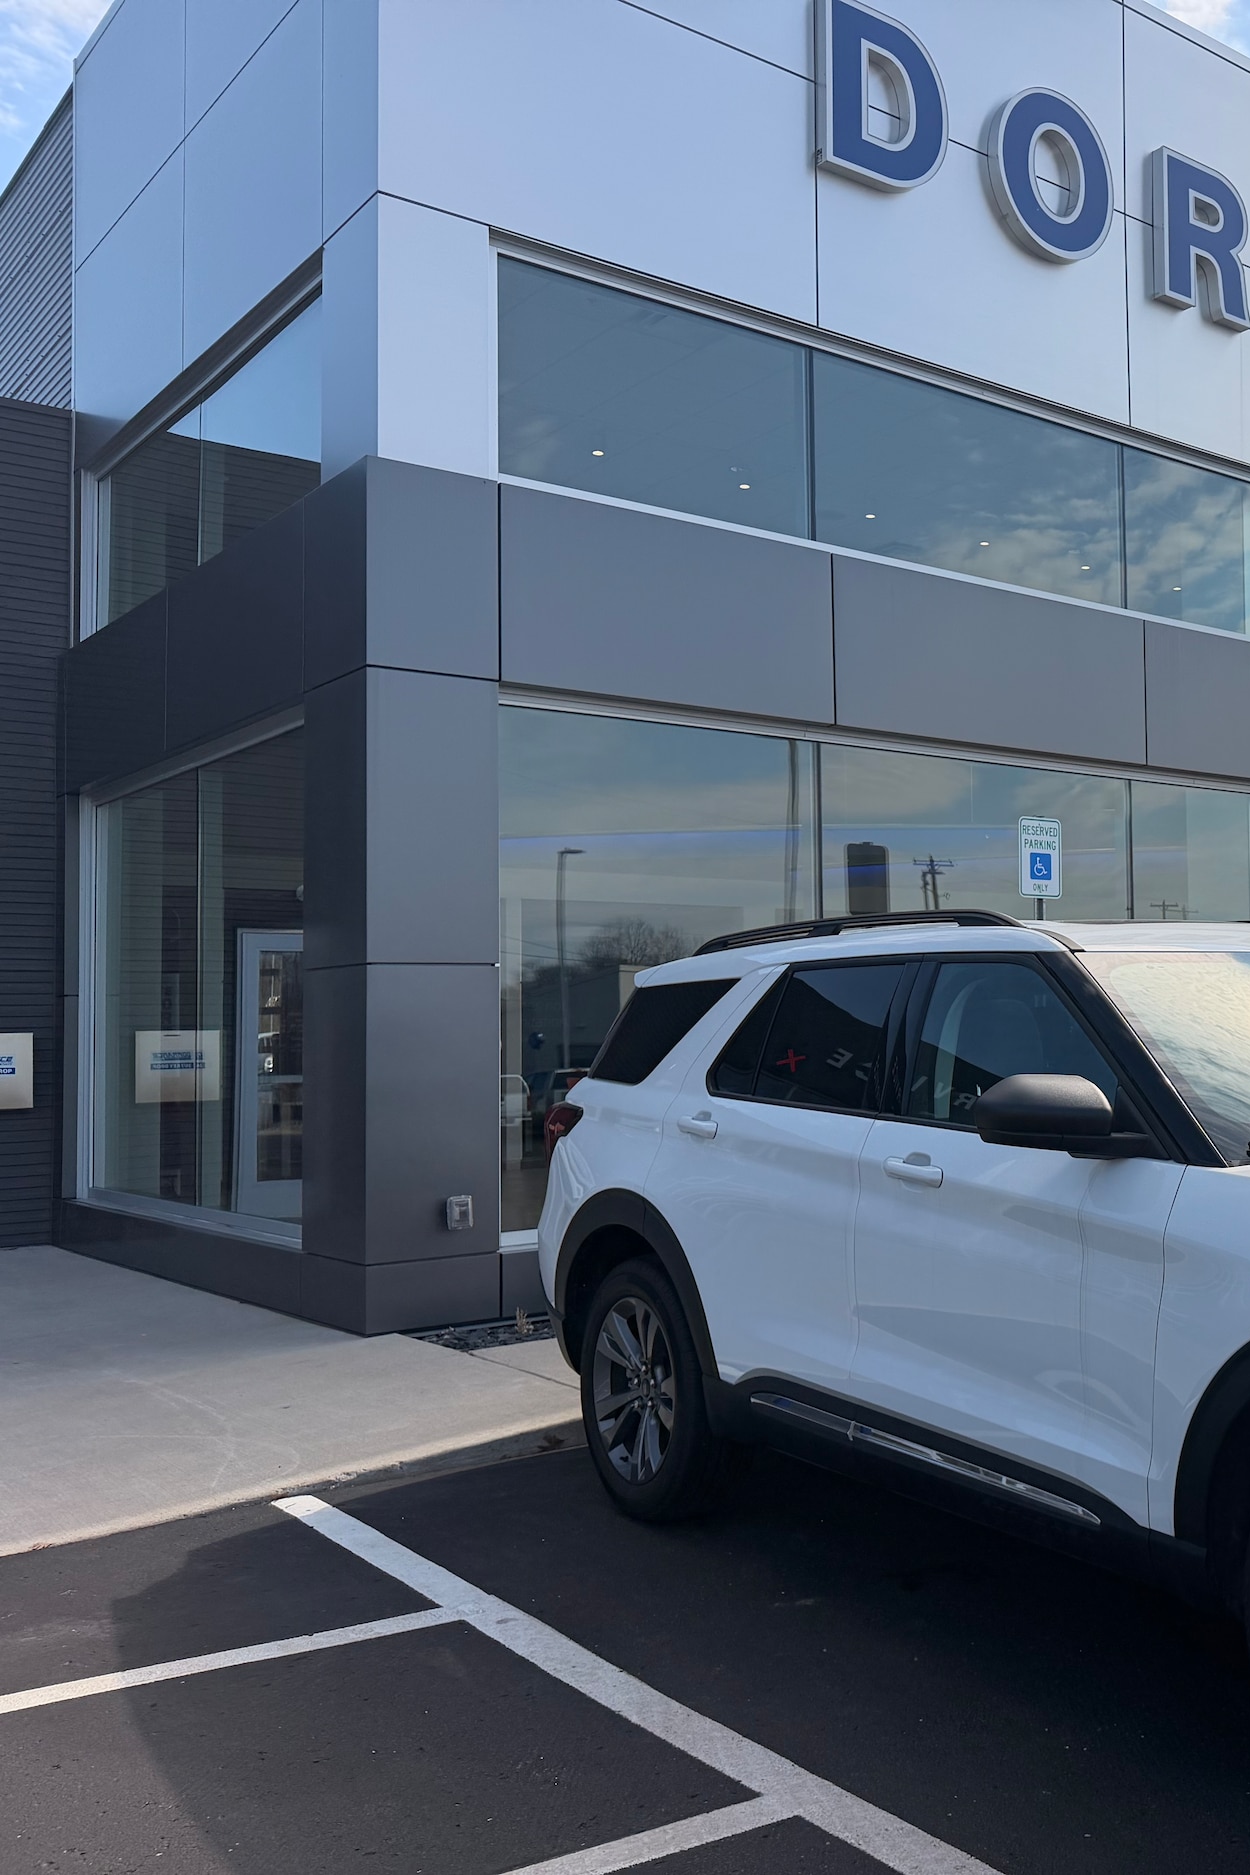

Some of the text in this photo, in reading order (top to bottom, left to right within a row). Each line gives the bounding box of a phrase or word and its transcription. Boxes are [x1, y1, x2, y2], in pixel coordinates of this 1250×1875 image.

[1022, 825, 1058, 837] RESERVED
[1024, 838, 1057, 851] PARKING
[1033, 883, 1049, 892] ONLY
